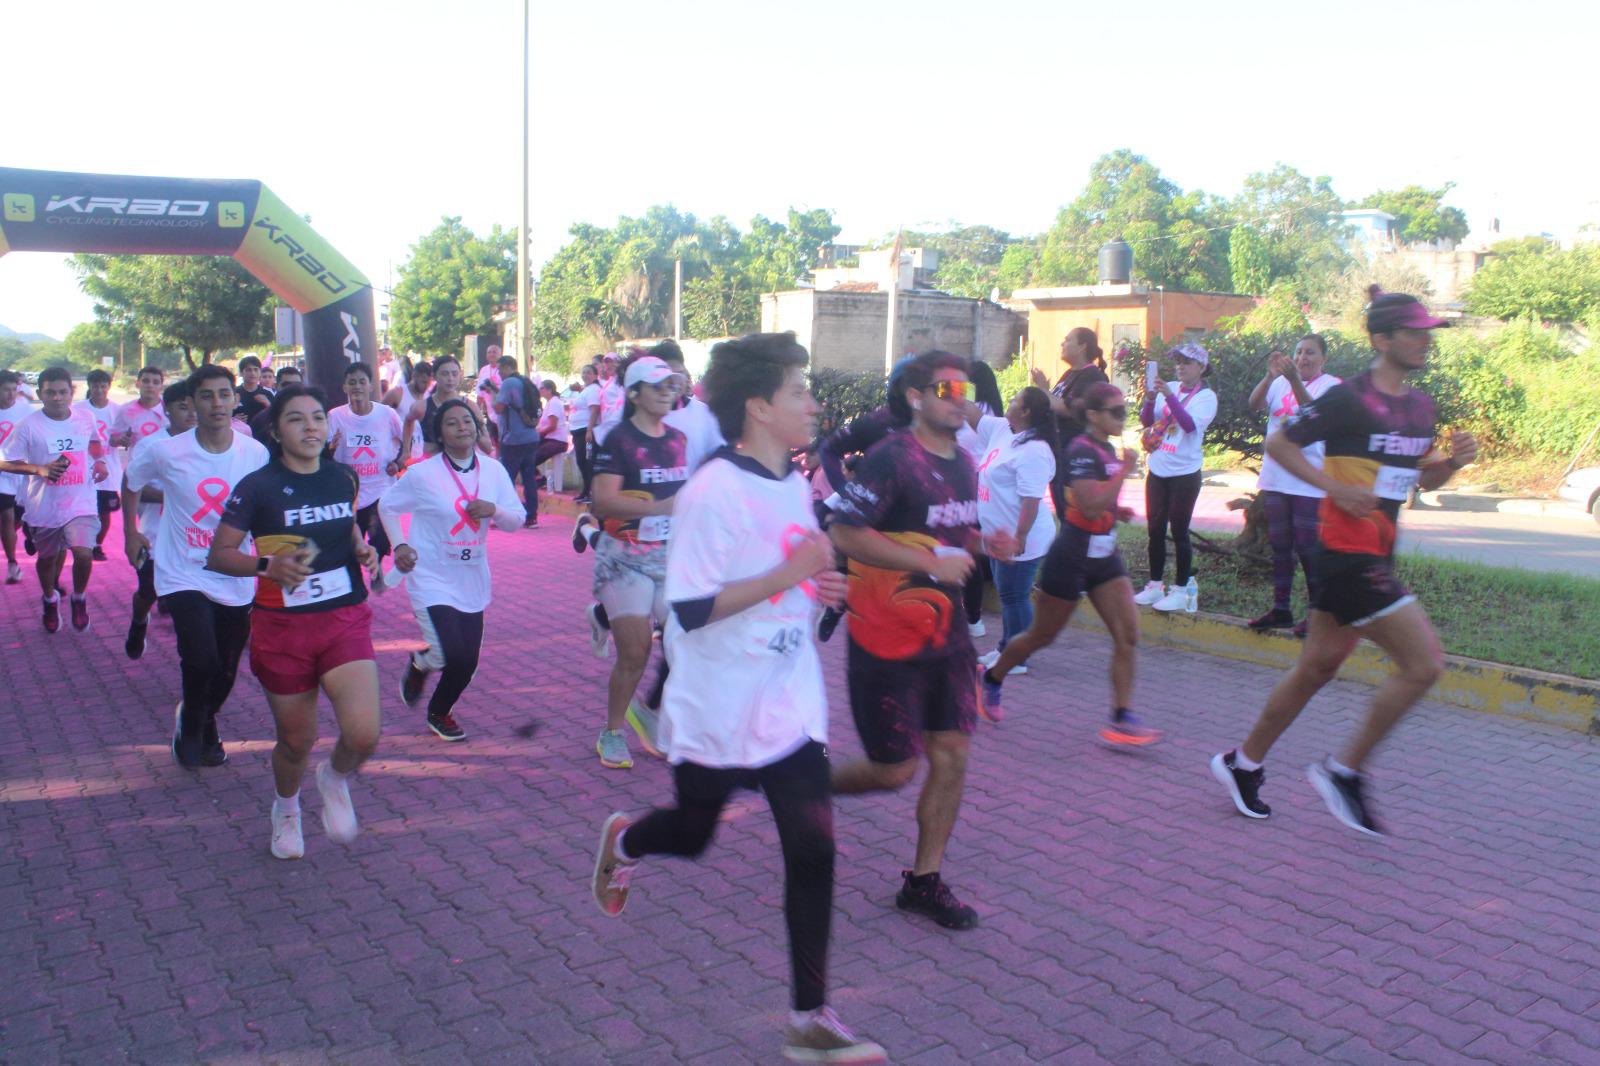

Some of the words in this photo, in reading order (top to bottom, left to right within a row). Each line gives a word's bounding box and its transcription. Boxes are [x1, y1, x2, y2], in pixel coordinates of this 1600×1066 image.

[56, 438, 74, 451] 32
[355, 434, 372, 446] 78
[284, 502, 353, 527] FÉNIX
[461, 548, 471, 560] 8
[310, 577, 324, 598] 5
